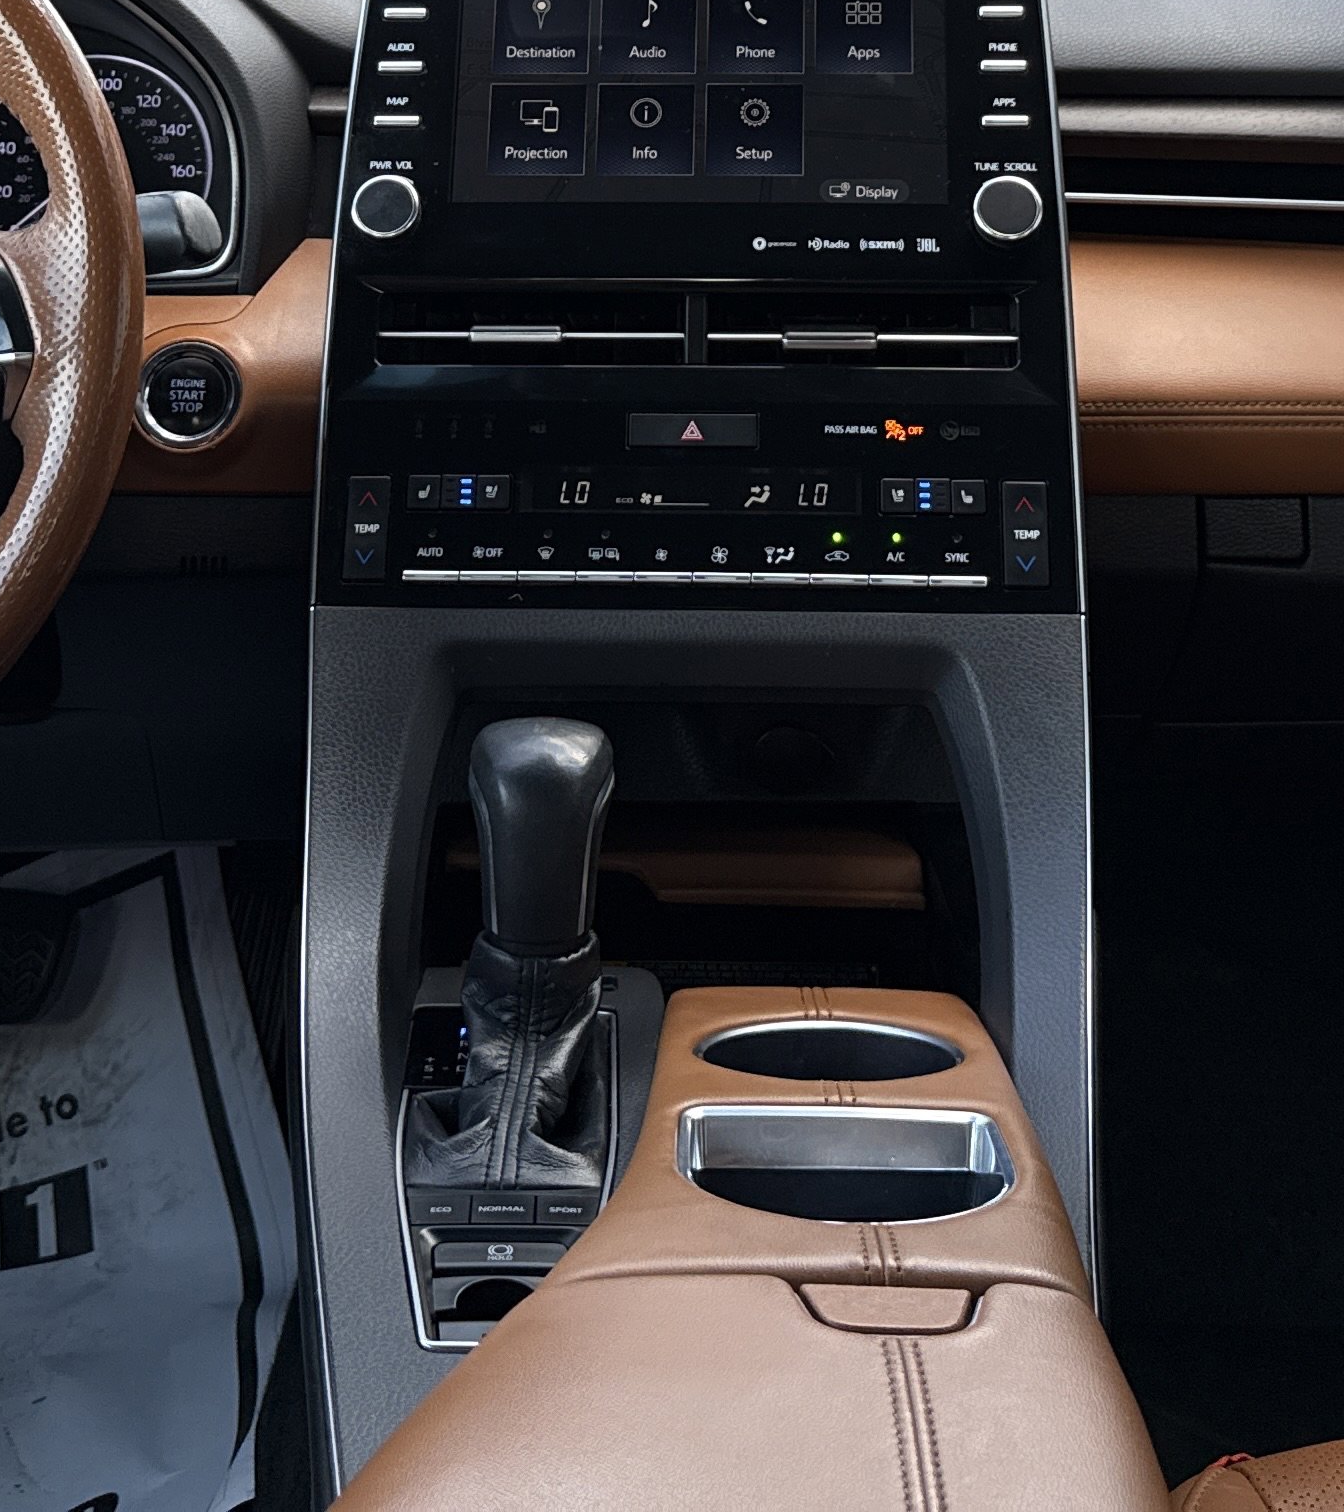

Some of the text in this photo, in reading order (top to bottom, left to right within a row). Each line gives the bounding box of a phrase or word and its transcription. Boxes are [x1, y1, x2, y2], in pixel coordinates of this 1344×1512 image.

[387, 43, 415, 52] AUDIO
[506, 45, 576, 59] Destination
[629, 45, 666, 58] Audio
[736, 45, 776, 58] Phone
[847, 45, 880, 61] Apps
[988, 43, 1018, 52] PHONE
[99, 78, 123, 91] 100
[136, 95, 161, 108] 120
[386, 97, 409, 106] MAP
[992, 98, 1016, 107] APPS
[160, 124, 187, 137] 140
[504, 145, 568, 162] Projection
[632, 146, 658, 159] Info
[736, 146, 773, 163] Setup
[170, 165, 195, 178] 160
[369, 161, 414, 170] PWR VOL
[974, 162, 1038, 172] TUNE SCROLL
[856, 185, 899, 199] Display
[823, 239, 850, 250] Radio
[916, 238, 940, 253] JBL
[170, 378, 206, 388] ENGINE
[169, 390, 206, 401] START
[171, 402, 204, 413] STOP
[824, 425, 844, 435] PASS
[859, 425, 877, 435] BAG
[907, 426, 924, 436] OFF
[354, 523, 381, 535] TEMP
[1013, 529, 1041, 541] TEMP
[416, 546, 444, 558] AUTO
[485, 547, 504, 558] OFF
[886, 551, 905, 563] A/C
[944, 552, 970, 564] SYNC
[39, 1089, 80, 1130] to
[429, 1205, 452, 1214] ECO
[478, 1205, 526, 1213] NORMAL
[548, 1205, 583, 1215] SPORT
